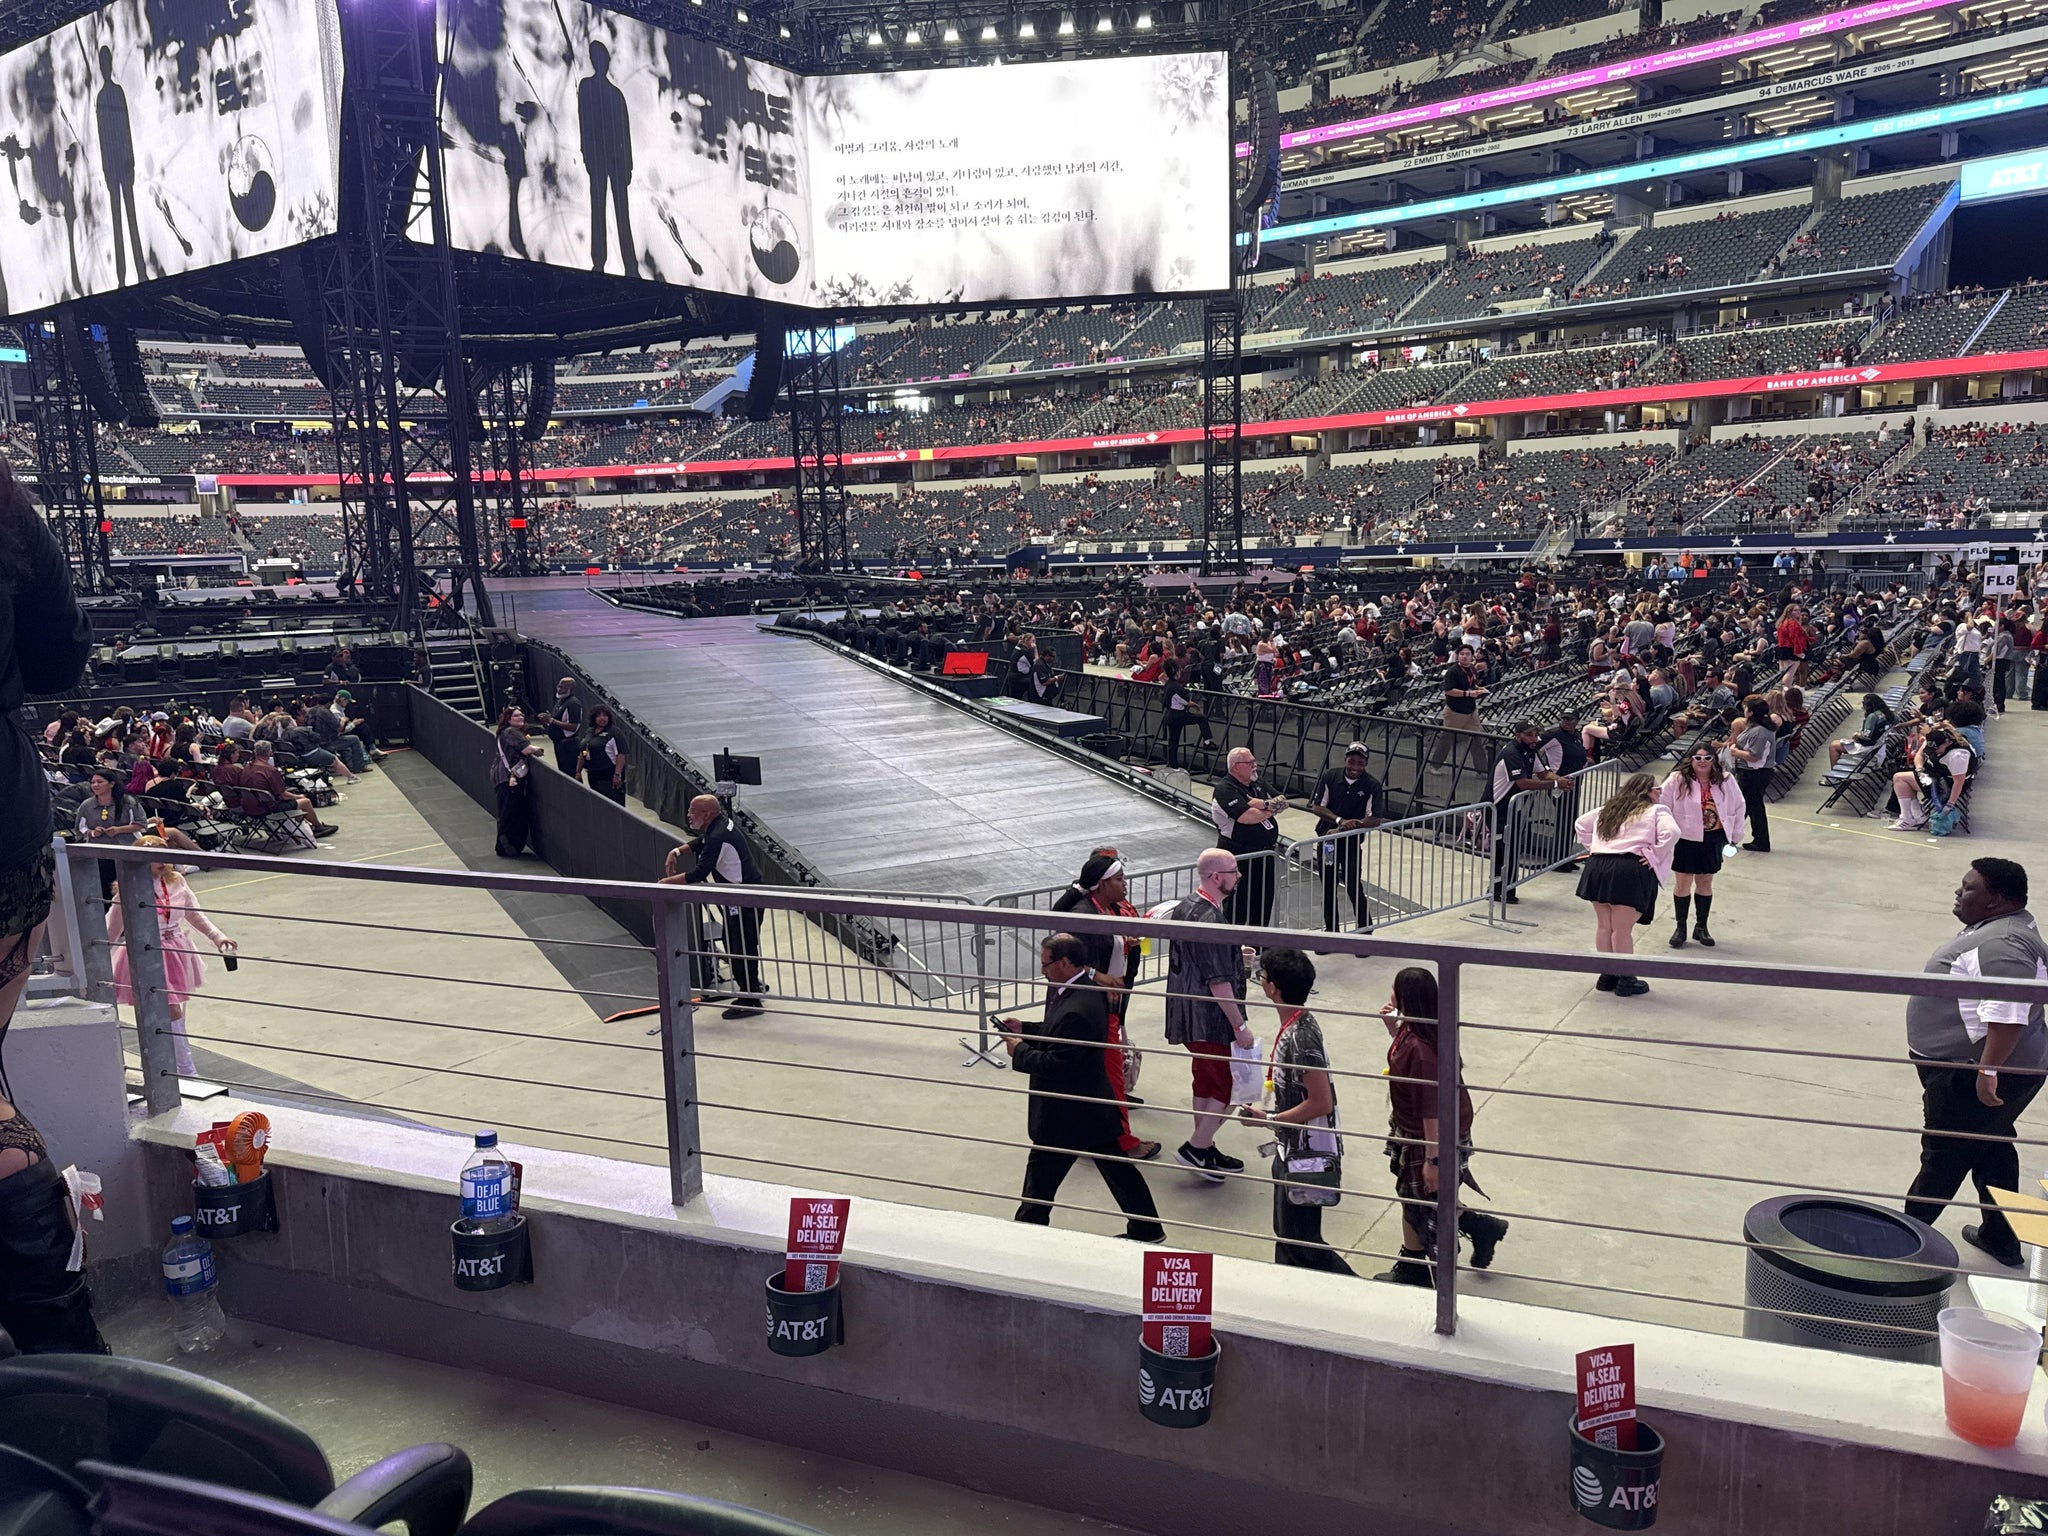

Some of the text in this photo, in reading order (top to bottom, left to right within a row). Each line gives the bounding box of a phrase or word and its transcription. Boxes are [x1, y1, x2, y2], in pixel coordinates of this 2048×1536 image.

[1759, 88, 1771, 97] 94
[1835, 68, 1867, 82] WARE
[1568, 128, 1578, 136] 73
[1581, 121, 1611, 134] LARRY
[1613, 115, 1643, 127] ALLEN
[1403, 160, 1412, 168] 22
[1414, 154, 1446, 166] EMMITT
[1446, 149, 1471, 160] SMITH
[1282, 178, 1308, 189] AIKMAN
[1767, 374, 1857, 389] BANK OF AMERICA
[1385, 414, 1405, 422] BANK
[1418, 410, 1452, 419] AMERICA
[1970, 547, 1989, 555] FL6
[2020, 550, 2042, 558] FL7
[1986, 575, 2015, 586] FL8
[477, 1183, 500, 1199] DEJA
[477, 1197, 500, 1212] BLUE
[807, 1203, 834, 1214] VISA
[196, 1205, 242, 1225] AT&T
[802, 1215, 839, 1229] IN-SEAT
[796, 1229, 840, 1244] DELIVERY
[457, 1253, 506, 1277] AT&T
[1161, 1257, 1191, 1270] VISA
[1156, 1271, 1198, 1287] IN-SEAT
[1151, 1287, 1202, 1303] DELIVERY
[776, 1316, 828, 1340] AT&T
[1589, 1352, 1614, 1369] VISA
[1586, 1366, 1621, 1388] IN-SEAT
[1158, 1384, 1214, 1411] AT&T
[1584, 1382, 1626, 1408] DELIVERY
[1608, 1478, 1660, 1511] AT&
